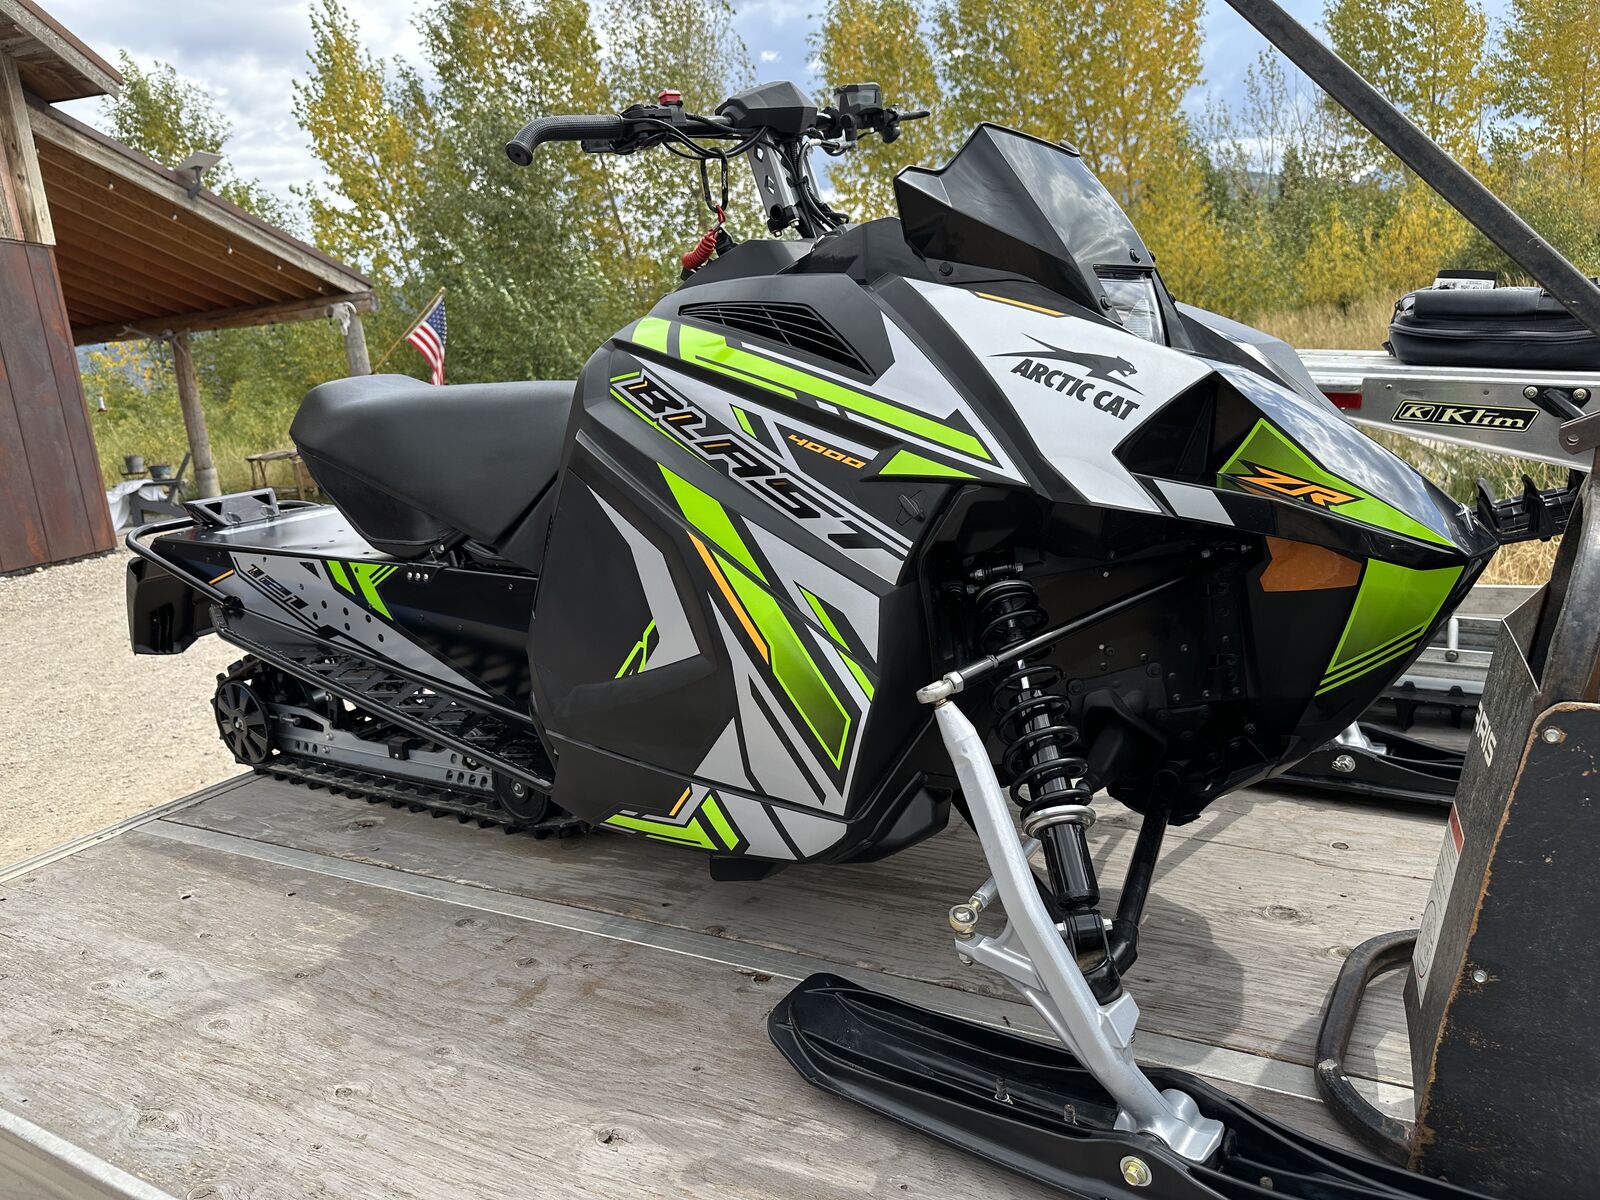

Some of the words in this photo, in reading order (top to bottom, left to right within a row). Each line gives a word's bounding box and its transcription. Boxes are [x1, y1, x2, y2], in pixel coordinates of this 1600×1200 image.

[1010, 358, 1095, 402] ARCTIC
[1093, 390, 1140, 421] CAT
[613, 370, 905, 562] BLAST
[787, 434, 867, 469] 4000
[1236, 465, 1357, 507] ZR
